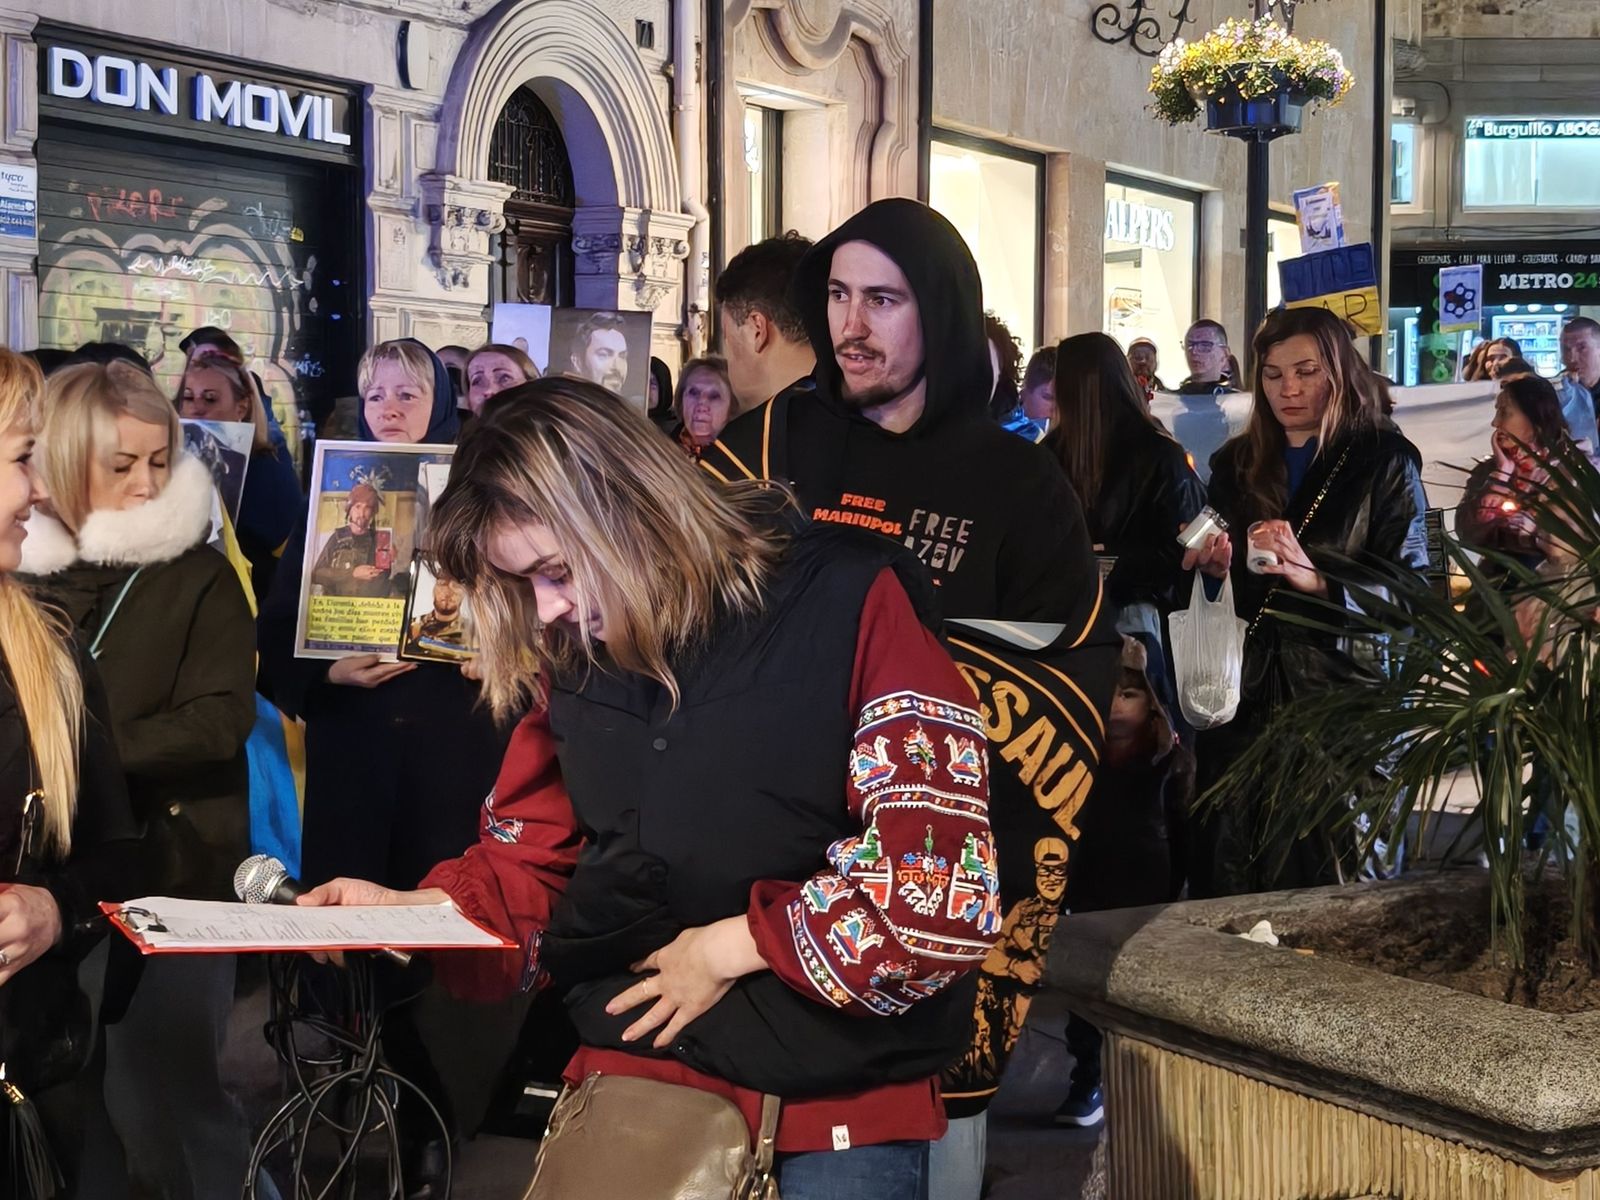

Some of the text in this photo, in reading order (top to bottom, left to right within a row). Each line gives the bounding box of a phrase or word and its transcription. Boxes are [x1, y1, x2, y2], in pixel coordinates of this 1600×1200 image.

[49, 46, 351, 146] DON MOVIL
[1484, 122, 1553, 140] Burguillo
[1498, 272, 1600, 290] METRO24
[840, 493, 887, 512] FREE
[812, 508, 903, 536] MARIUPOL
[908, 508, 974, 544] FREE
